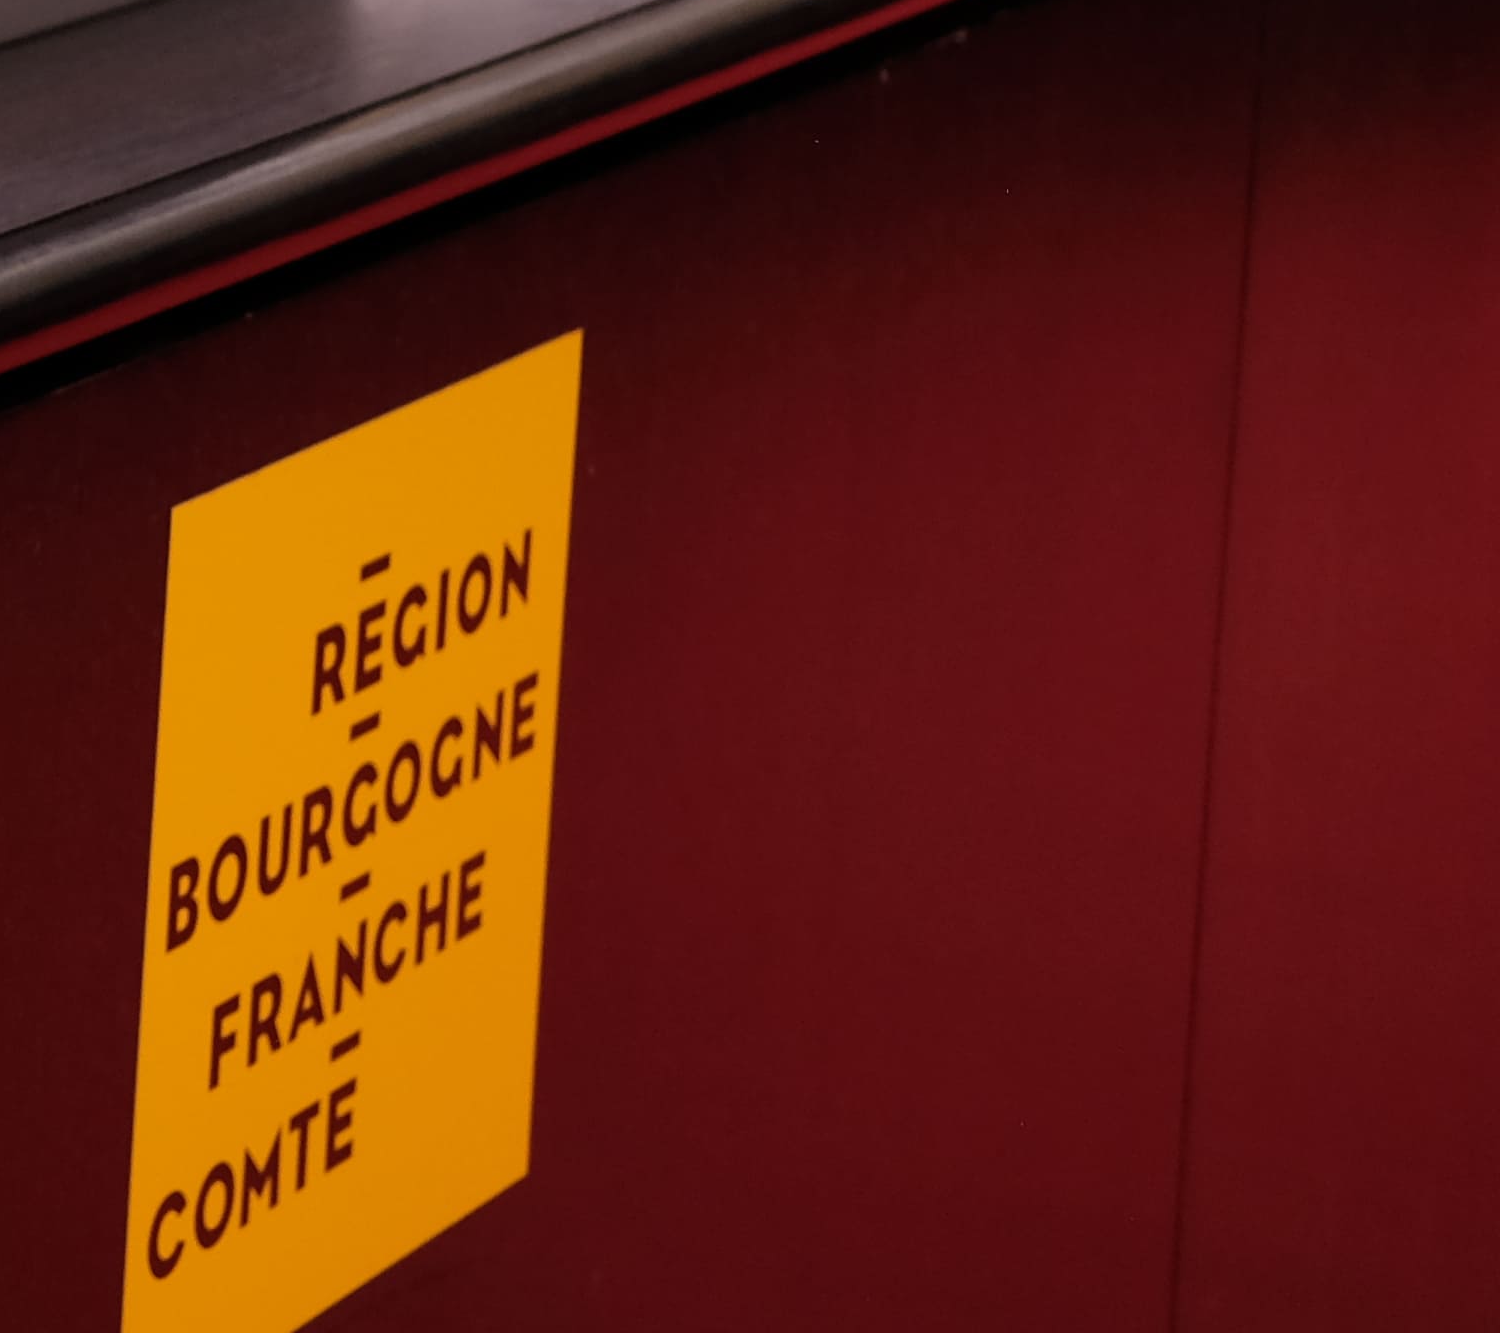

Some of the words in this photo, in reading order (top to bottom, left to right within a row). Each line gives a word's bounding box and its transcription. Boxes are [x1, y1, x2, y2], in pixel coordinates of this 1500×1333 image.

[309, 527, 534, 716] RÉGION
[164, 670, 540, 954] BOURGOGNE
[207, 849, 488, 1091] FRANCHE
[146, 1031, 362, 1281] COMTÉ
